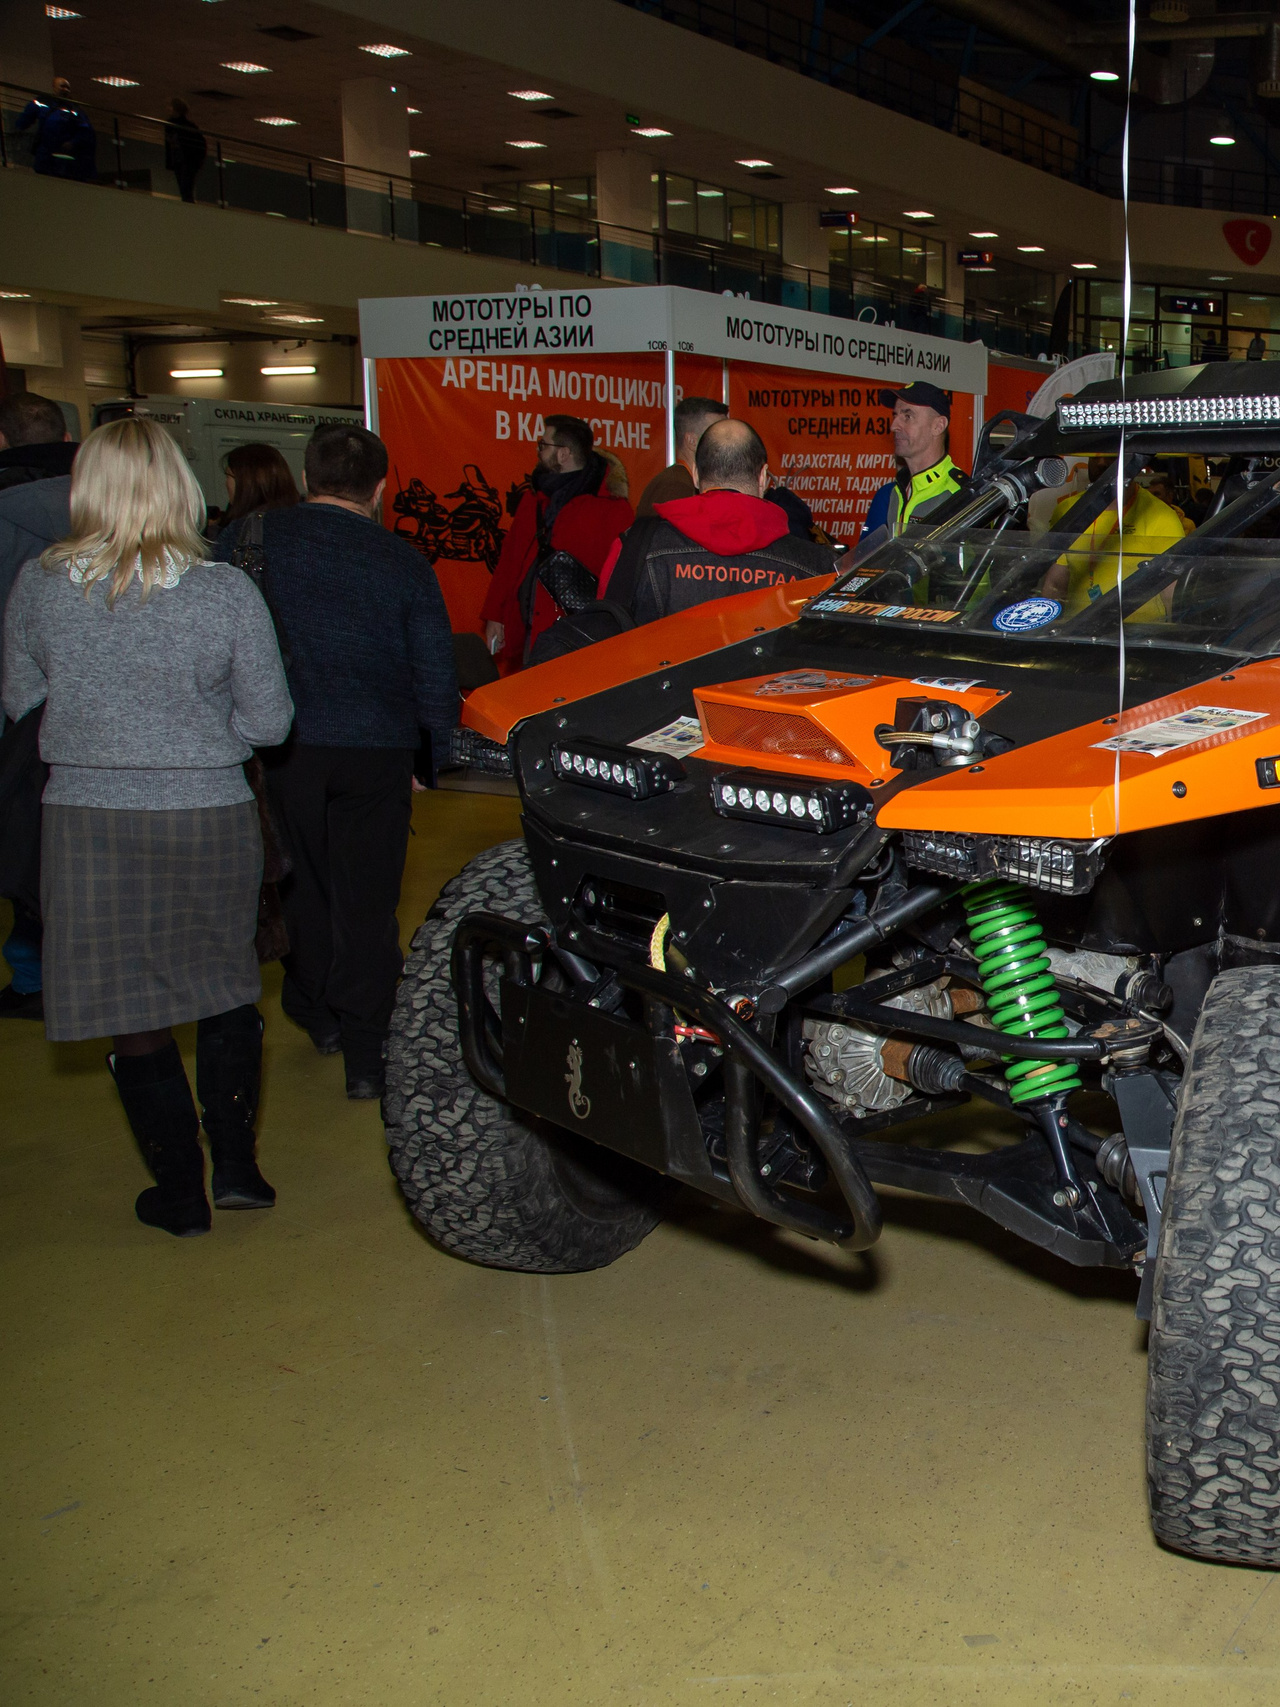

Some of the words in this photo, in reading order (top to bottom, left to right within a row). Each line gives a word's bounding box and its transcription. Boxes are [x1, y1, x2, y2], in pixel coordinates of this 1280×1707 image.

[432, 296, 553, 323] МОТОТУРЫ
[559, 295, 592, 318] ПО
[1208, 302, 1214, 313] 1
[428, 321, 528, 354] СРЕДНЕЙ
[533, 325, 594, 348] АЗИИ
[726, 316, 819, 353] МОТОТУРЫ
[823, 334, 845, 357] ПО
[848, 338, 914, 368] СРЕДНЕЙ
[916, 350, 951, 373] АЗИИ
[441, 358, 543, 401] АРЕНДА
[748, 389, 836, 408] МОТОТУРЫ
[839, 390, 862, 407] ПО
[214, 408, 255, 422] СКЛАД
[256, 411, 316, 425] ХРАНЕНИЯ
[496, 410, 511, 440] В
[788, 412, 861, 439] СРЕДНЕЙ
[781, 453, 852, 472] КАЗАХСТАН,
